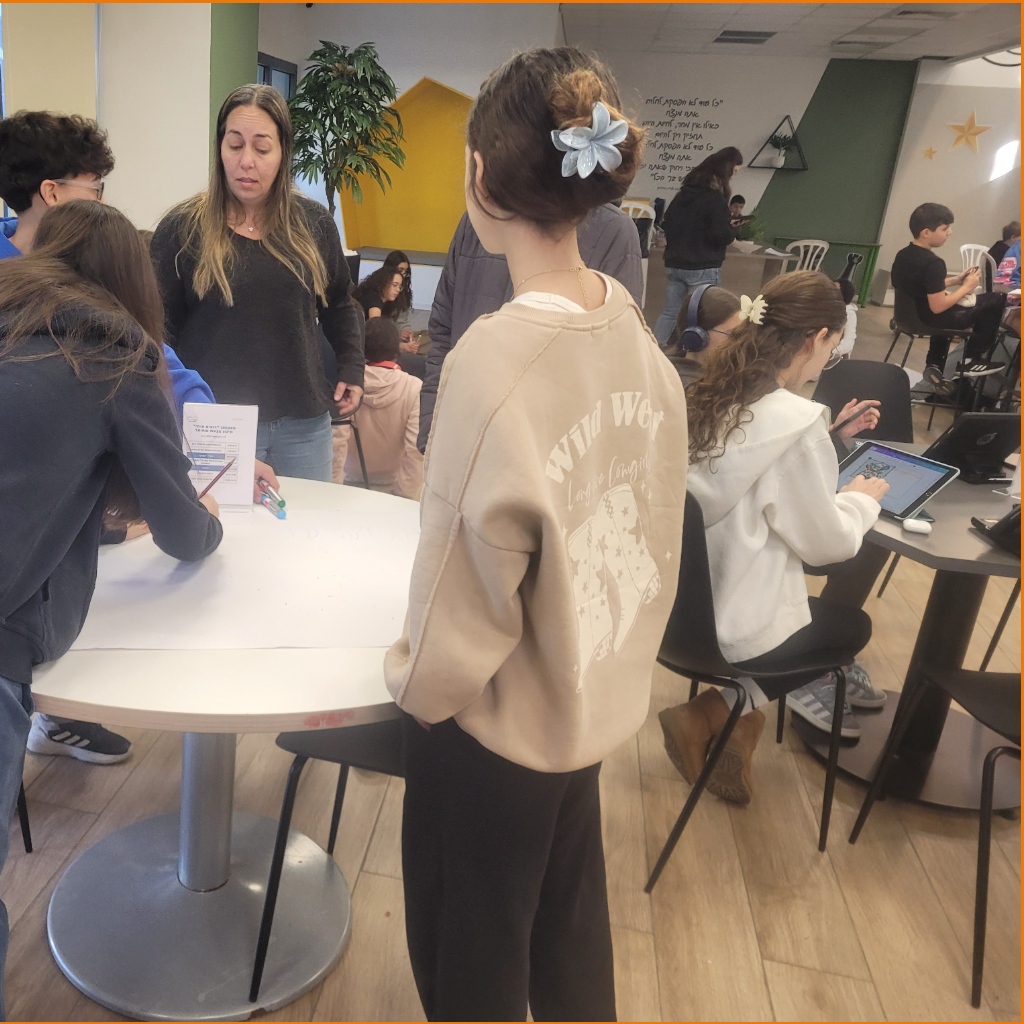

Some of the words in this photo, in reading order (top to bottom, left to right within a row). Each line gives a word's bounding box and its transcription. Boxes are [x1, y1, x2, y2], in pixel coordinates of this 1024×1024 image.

[688, 98, 699, 106] לא
[666, 108, 682, 118] מנצח
[692, 122, 702, 131] אין
[683, 142, 693, 150] לא
[706, 143, 714, 151] כל
[659, 152, 675, 161] מנצח
[545, 399, 602, 484] Wild
